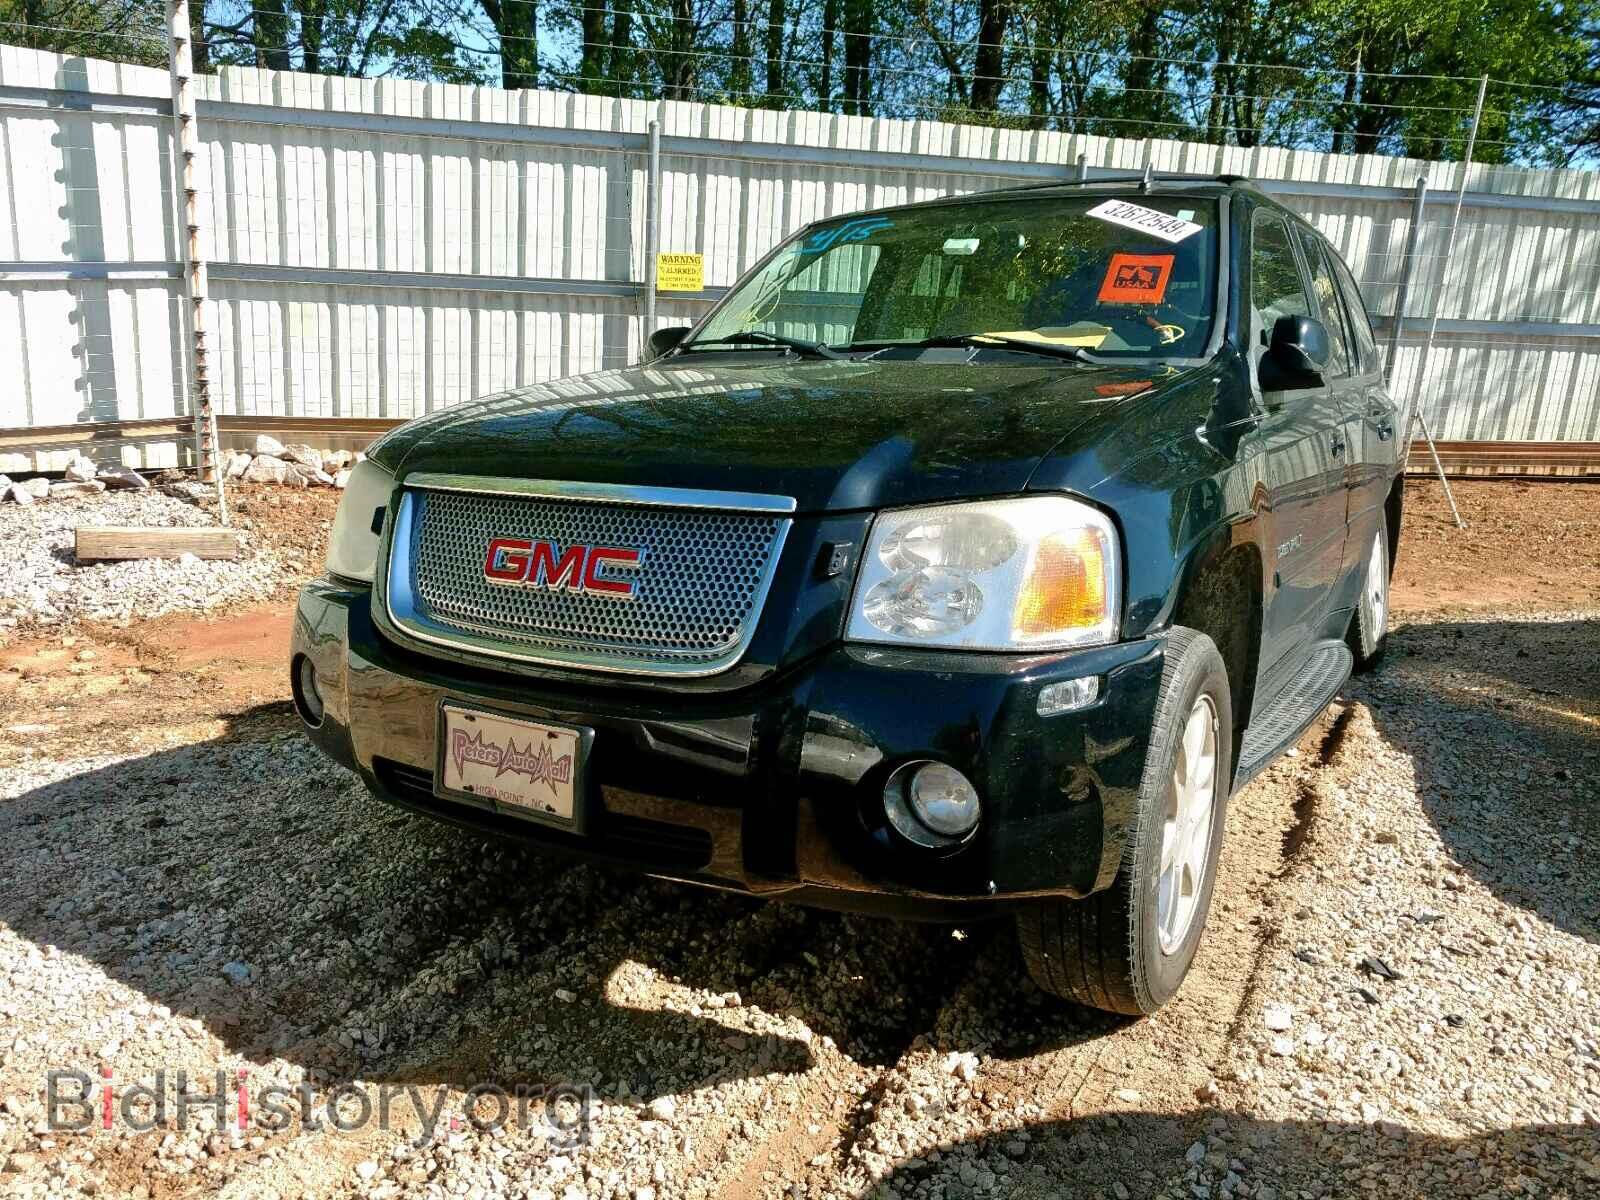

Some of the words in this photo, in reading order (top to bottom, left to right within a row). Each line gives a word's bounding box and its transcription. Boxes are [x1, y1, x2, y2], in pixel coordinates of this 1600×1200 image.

[661, 255, 701, 265] WARNING
[484, 537, 646, 600] GMC
[453, 728, 501, 781] Peters
[496, 737, 537, 780] Auto
[530, 740, 571, 797] Mall
[475, 783, 497, 797] HIGH
